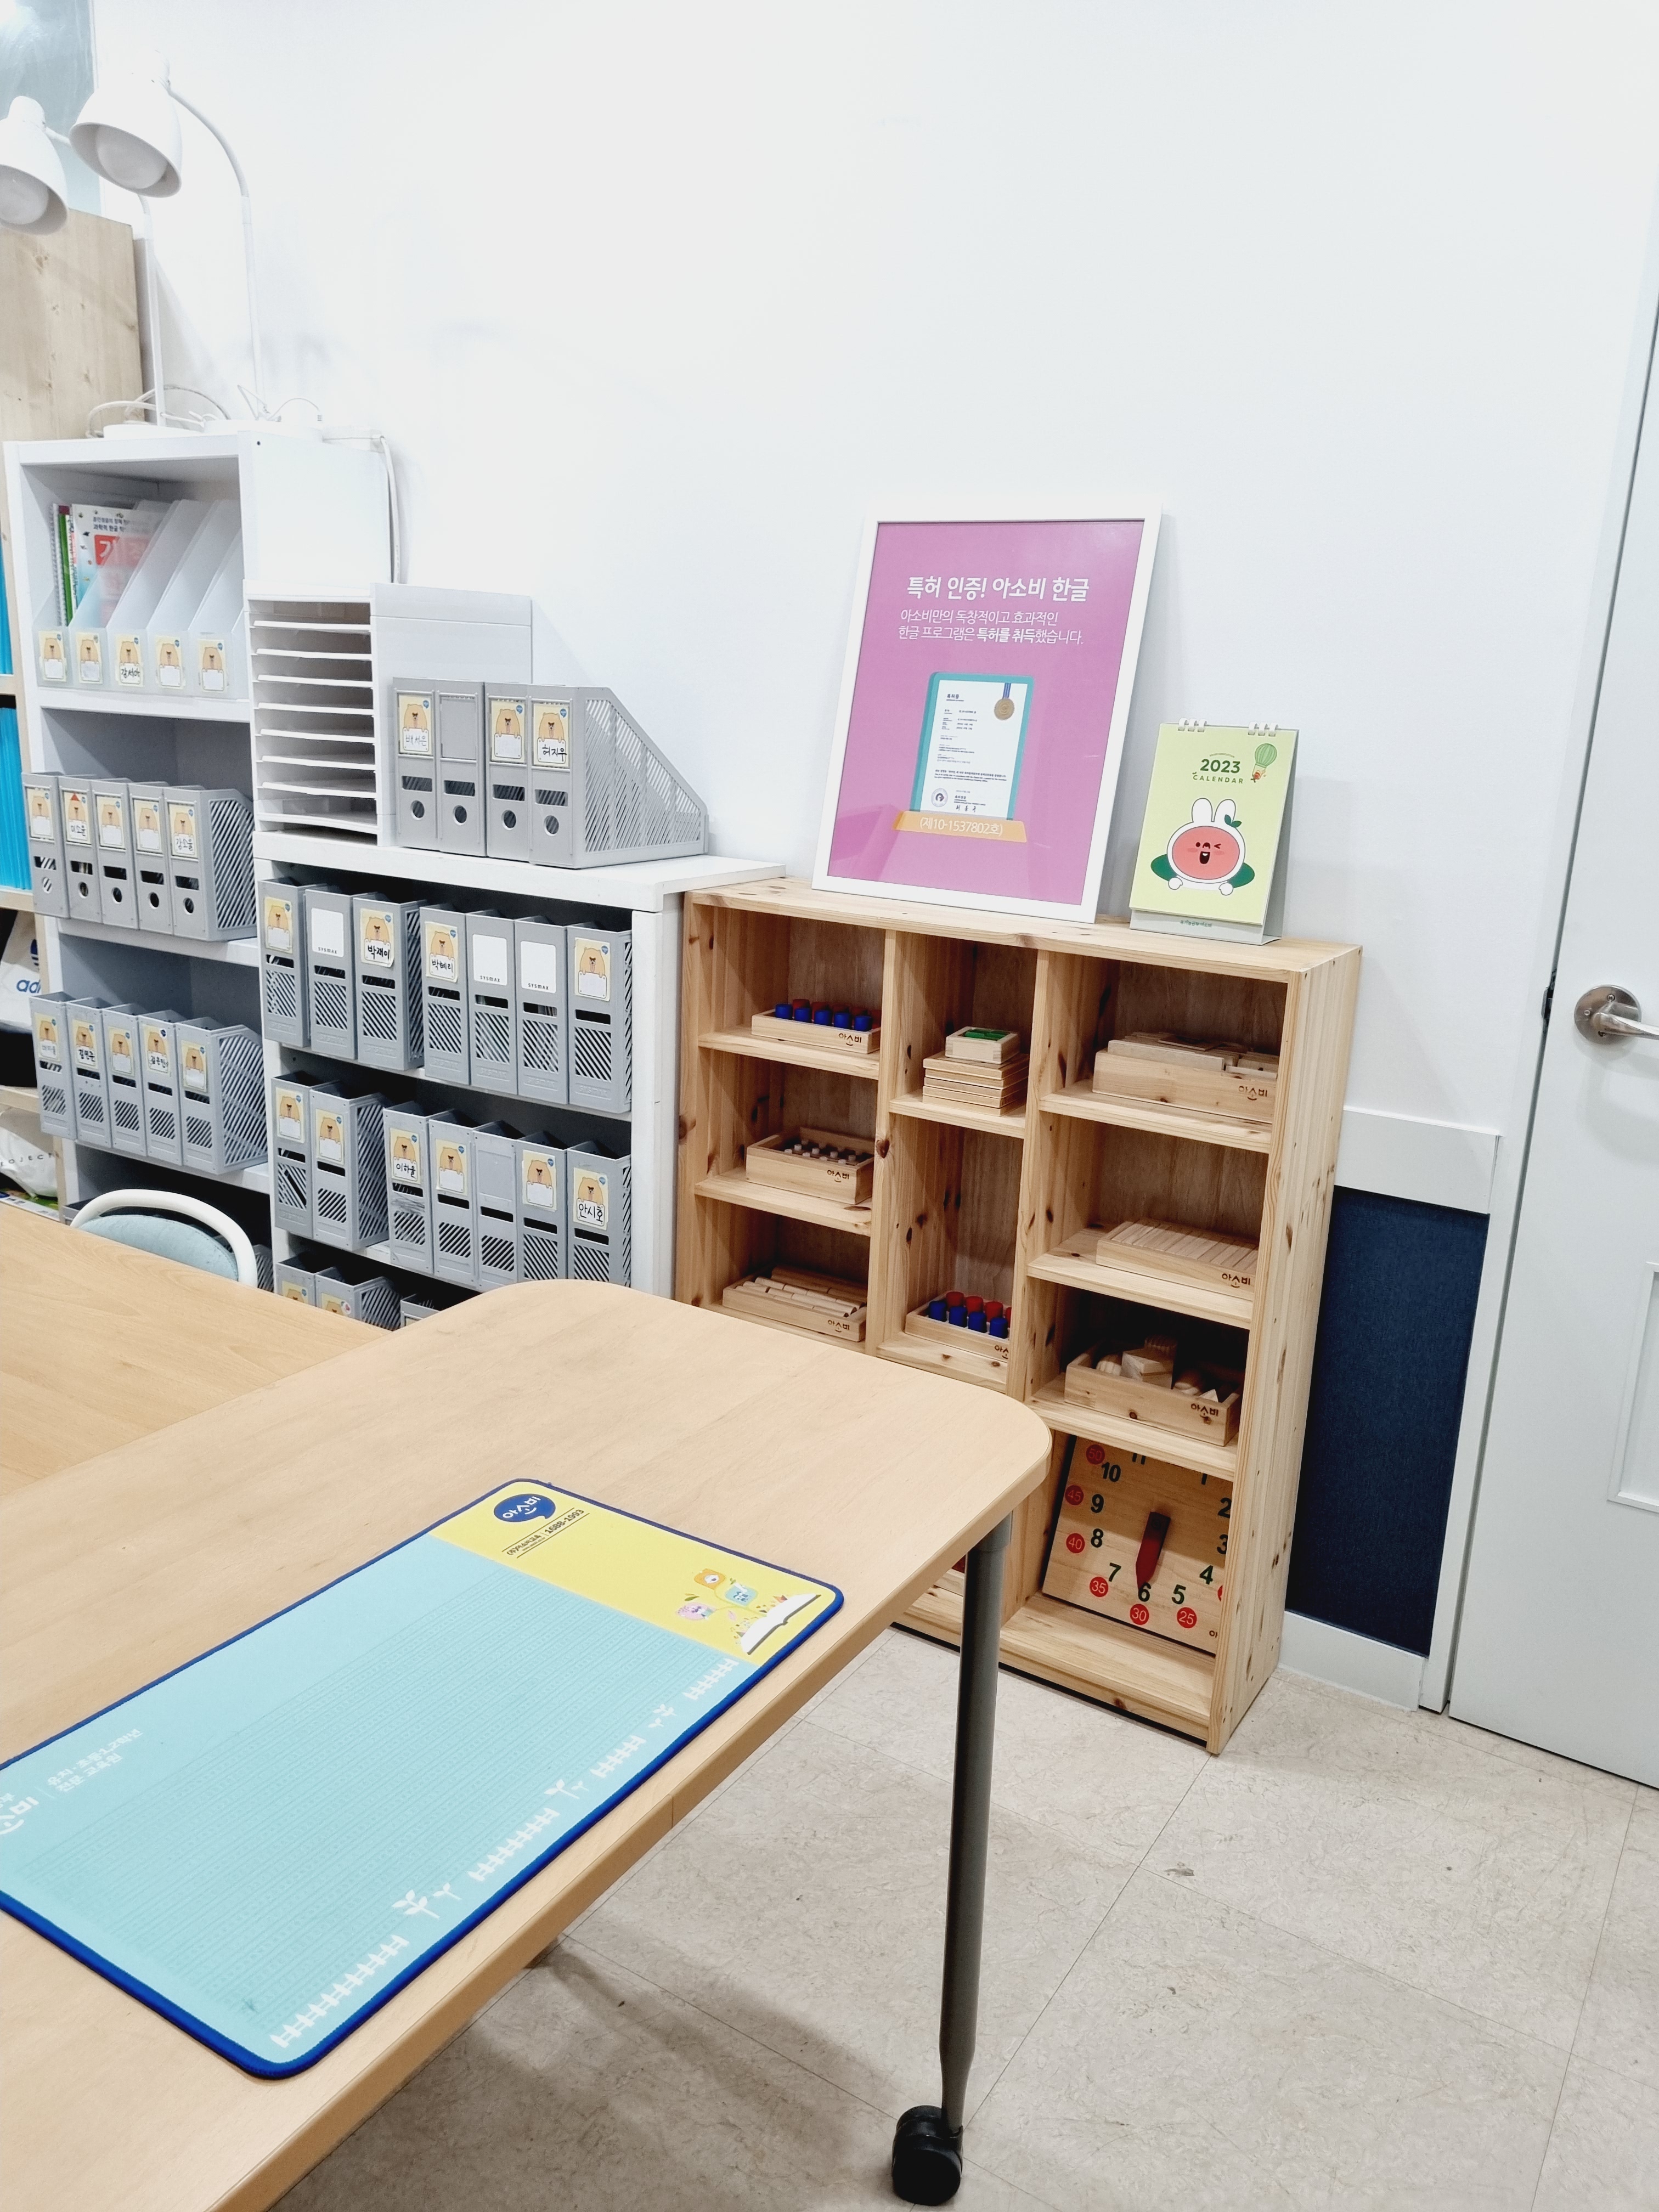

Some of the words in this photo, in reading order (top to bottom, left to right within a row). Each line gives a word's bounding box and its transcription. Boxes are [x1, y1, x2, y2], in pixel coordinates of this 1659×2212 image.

[907, 575, 941, 599] 특허
[947, 577, 988, 601] 인증!
[992, 578, 1046, 600] 아소비
[1052, 577, 1089, 602] 한글
[901, 610, 954, 623] 아소비만의
[955, 610, 1010, 624] 독창적이고
[1012, 611, 1058, 626] 효과적인
[898, 625, 919, 640] 한글
[921, 627, 975, 641] 프로그램은
[976, 628, 1011, 642] 특허를
[1012, 628, 1084, 645] 취득했습니다.
[542, 744, 567, 762] 허지우
[1200, 759, 1240, 774] 2023
[1193, 775, 1244, 784] CALENDAR
[919, 816, 1003, 837] (제10-1537802호)
[838, 1033, 862, 1046] 아소비
[1239, 1086, 1268, 1101] 아소비
[827, 1170, 849, 1183] 아소비
[579, 1203, 603, 1222] 안시호
[1222, 1273, 1250, 1288] 아소비
[828, 1320, 850, 1333] 아소비
[1191, 1403, 1219, 1419] 아소비
[1089, 1448, 1102, 1460] 50
[1102, 1462, 1121, 1482] 10
[1068, 1489, 1082, 1502] 45
[1091, 1494, 1104, 1513] 9
[503, 1496, 541, 1519] 아소비
[1217, 1497, 1232, 1519] 2
[544, 1509, 584, 1534] 1688-1993
[1068, 1537, 1082, 1550] 40
[1091, 1528, 1104, 1548] 8
[1216, 1534, 1228, 1555] 3
[1108, 1562, 1121, 1582] 7
[1199, 1565, 1214, 1585] 4
[1091, 1580, 1107, 1594] 35
[1138, 1582, 1152, 1602] 6
[1171, 1584, 1186, 1605] 5
[1132, 1607, 1147, 1622] 30
[1179, 1611, 1195, 1625] 25
